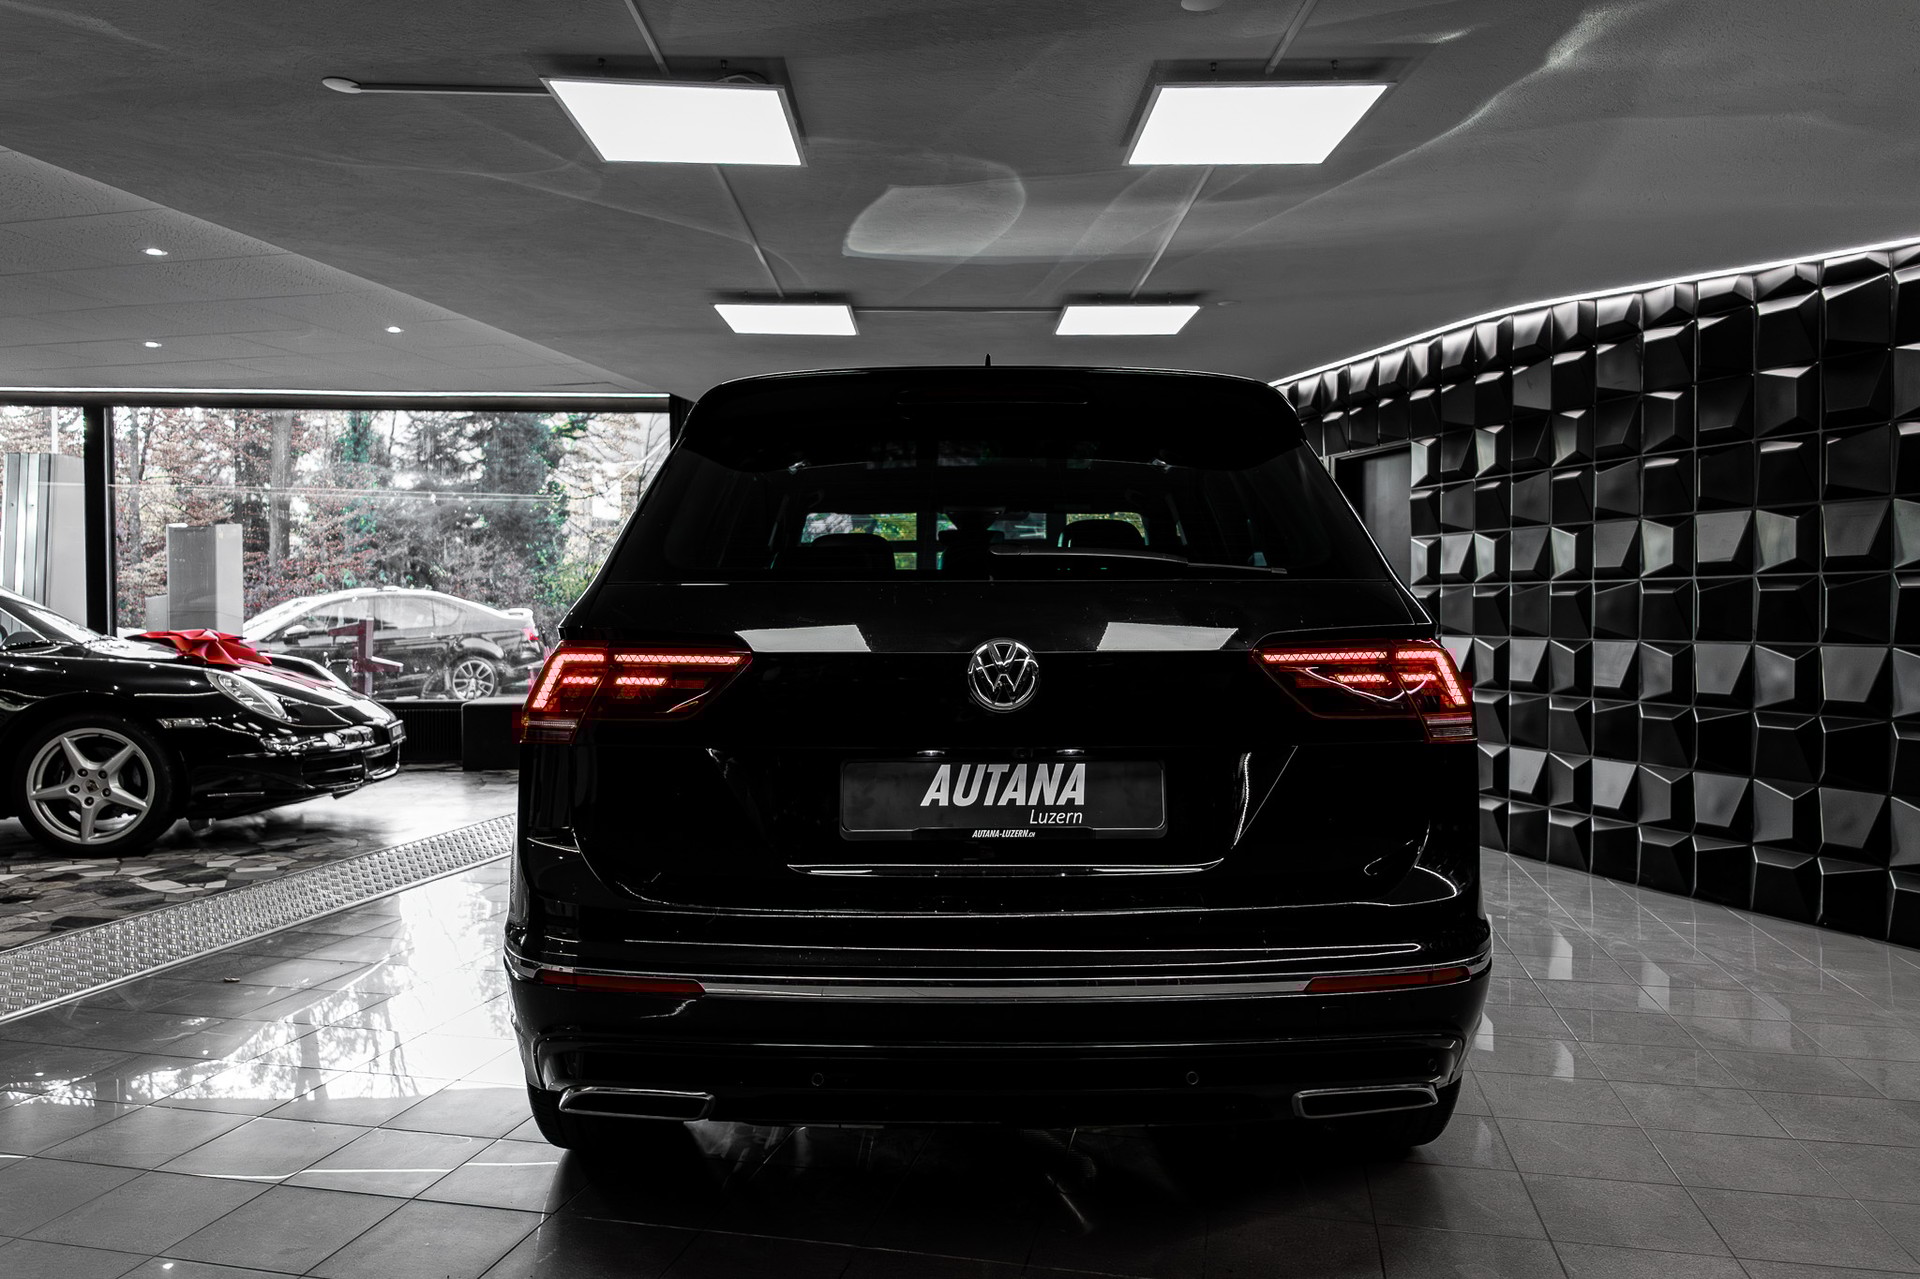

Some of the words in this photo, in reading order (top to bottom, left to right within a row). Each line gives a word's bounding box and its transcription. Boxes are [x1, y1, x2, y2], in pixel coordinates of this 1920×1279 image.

[973, 641, 1036, 706] VW
[920, 763, 1086, 807] AUTANA
[1029, 809, 1083, 825] Luzern
